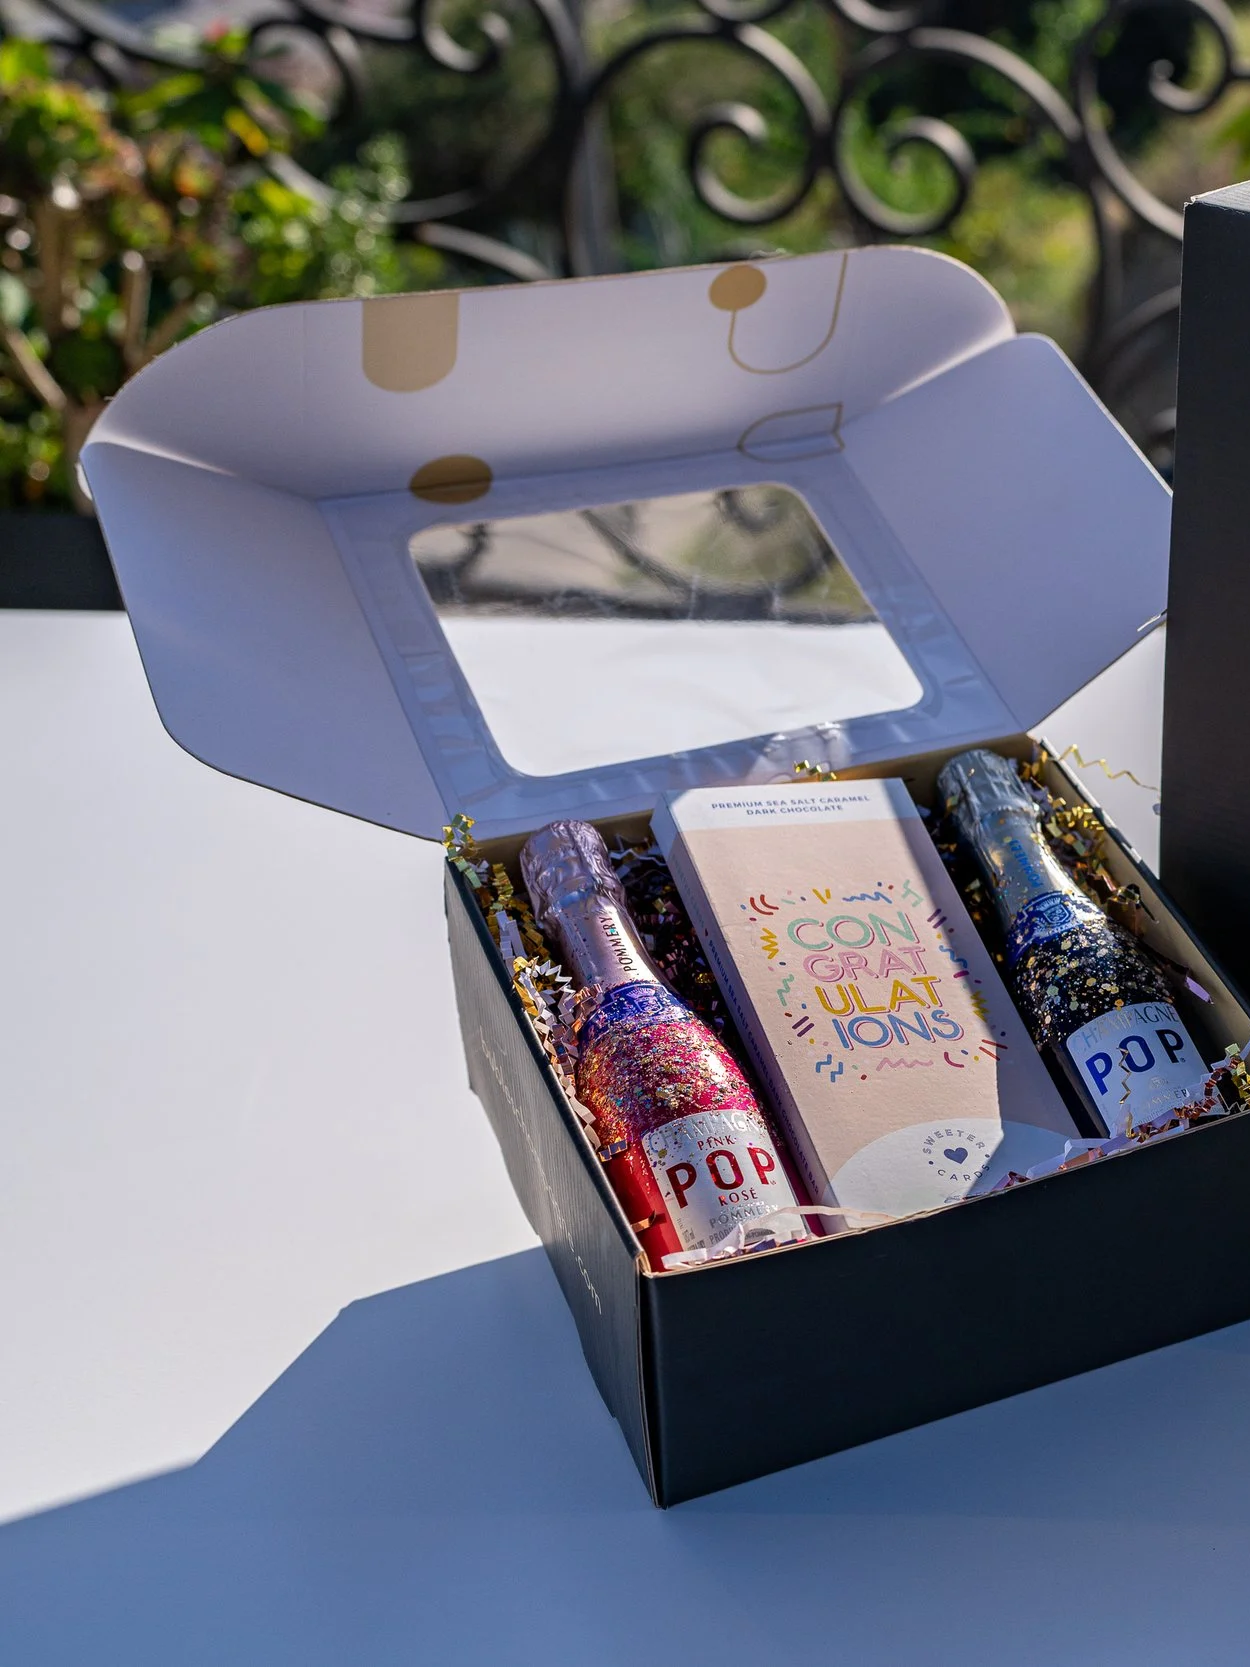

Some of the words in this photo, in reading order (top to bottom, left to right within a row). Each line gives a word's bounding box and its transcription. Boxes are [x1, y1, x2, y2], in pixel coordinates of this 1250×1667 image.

[711, 801, 763, 809] PREMIUM
[766, 799, 788, 807] SEA
[790, 797, 816, 806] SALT
[819, 795, 870, 804] CARAMEL
[746, 808, 777, 816] DARK
[780, 805, 843, 814] CHOCOLATE
[600, 916, 638, 972] POMMERY
[787, 911, 920, 951] CON
[802, 946, 927, 982] GRAT
[814, 975, 942, 1016] ULAT
[832, 1009, 964, 1050] IONS
[1073, 1005, 1181, 1050] CHAMPAGNE
[1085, 1029, 1184, 1096] POP
[697, 1135, 736, 1151] PINK
[922, 1128, 986, 1155] SWEETER
[666, 1147, 775, 1209] POP
[937, 1164, 990, 1182] CARDS
[718, 1187, 758, 1206] ROSÉ
